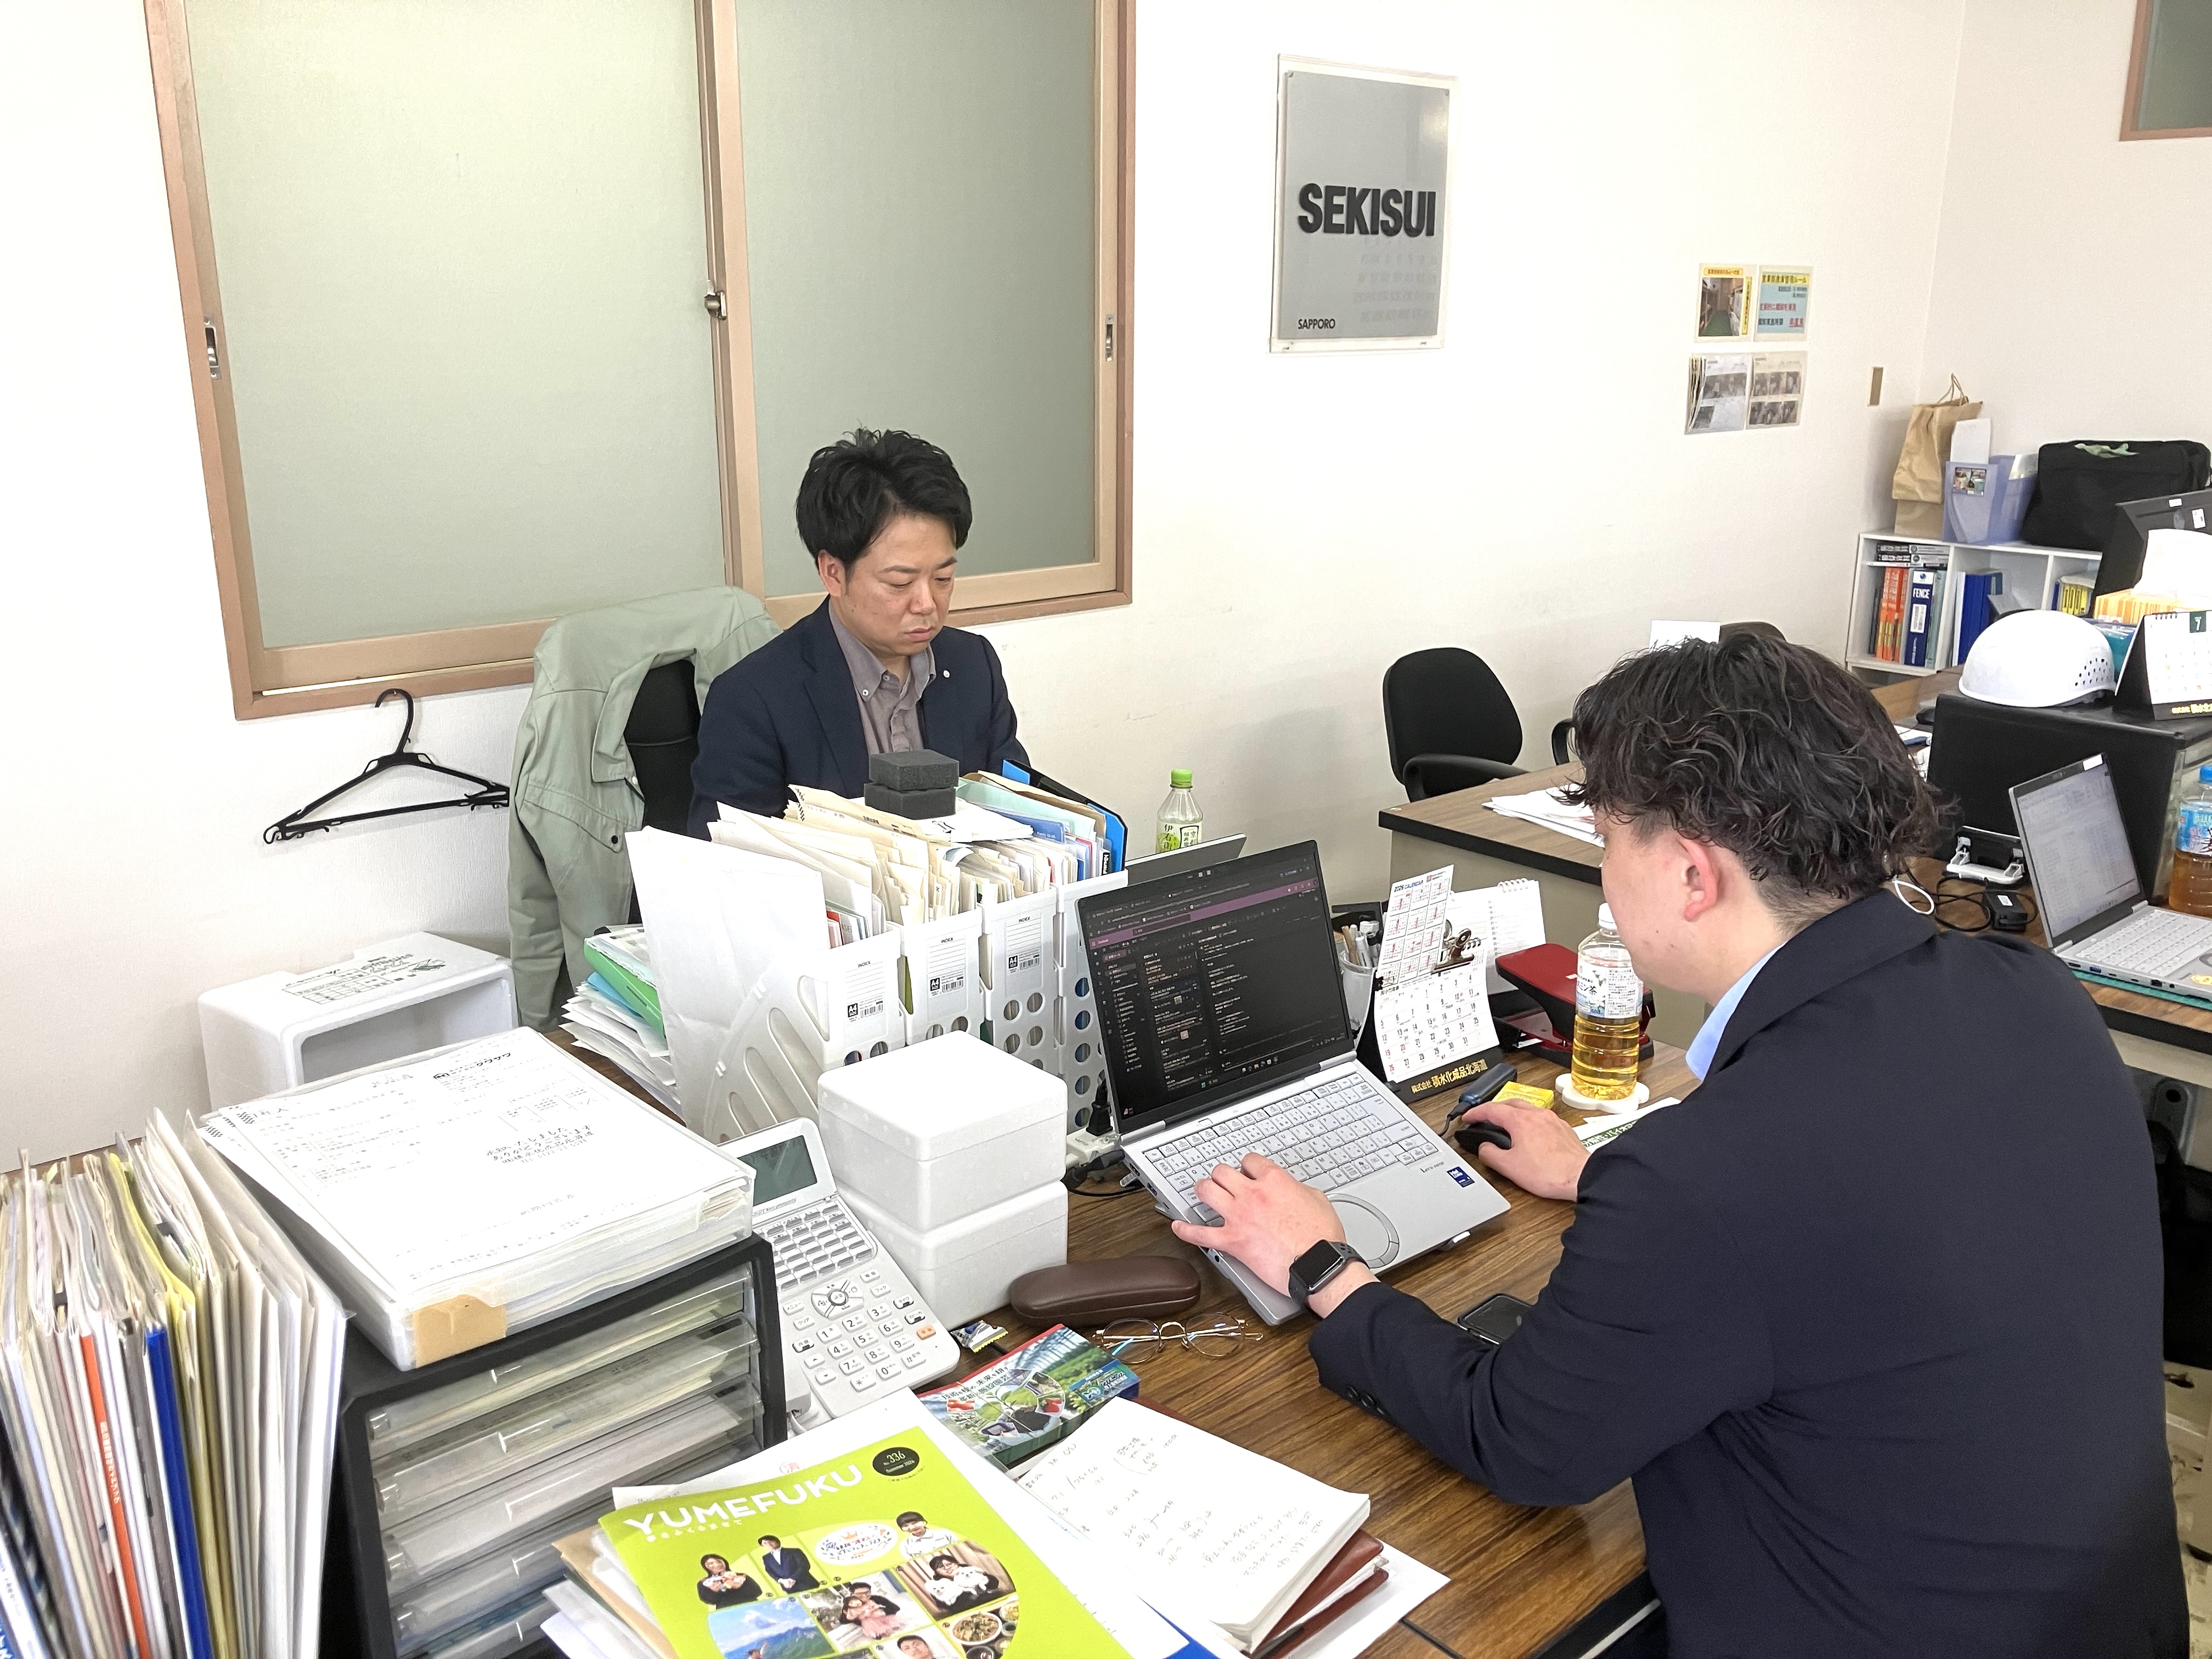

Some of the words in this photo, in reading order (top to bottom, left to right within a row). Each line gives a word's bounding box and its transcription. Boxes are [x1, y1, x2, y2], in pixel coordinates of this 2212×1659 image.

[1298, 183, 1436, 237] SEKISUI
[1298, 318, 1336, 330] SAPPORO
[1913, 589, 1931, 599] FENCE
[2195, 619, 2202, 630] 7
[849, 1004, 857, 1013] A4
[1411, 1080, 1433, 1094] 株式会社
[1431, 1059, 1488, 1088] 積水化成品北海道
[486, 1127, 568, 1156] 承知いたしました
[493, 1125, 591, 1161] ありがとうございます
[798, 1317, 809, 1325] クリア
[843, 1362, 850, 1370] 7
[887, 1451, 906, 1463] 336
[885, 1464, 905, 1474] Summer
[623, 1464, 864, 1538] YUMEFUKU
